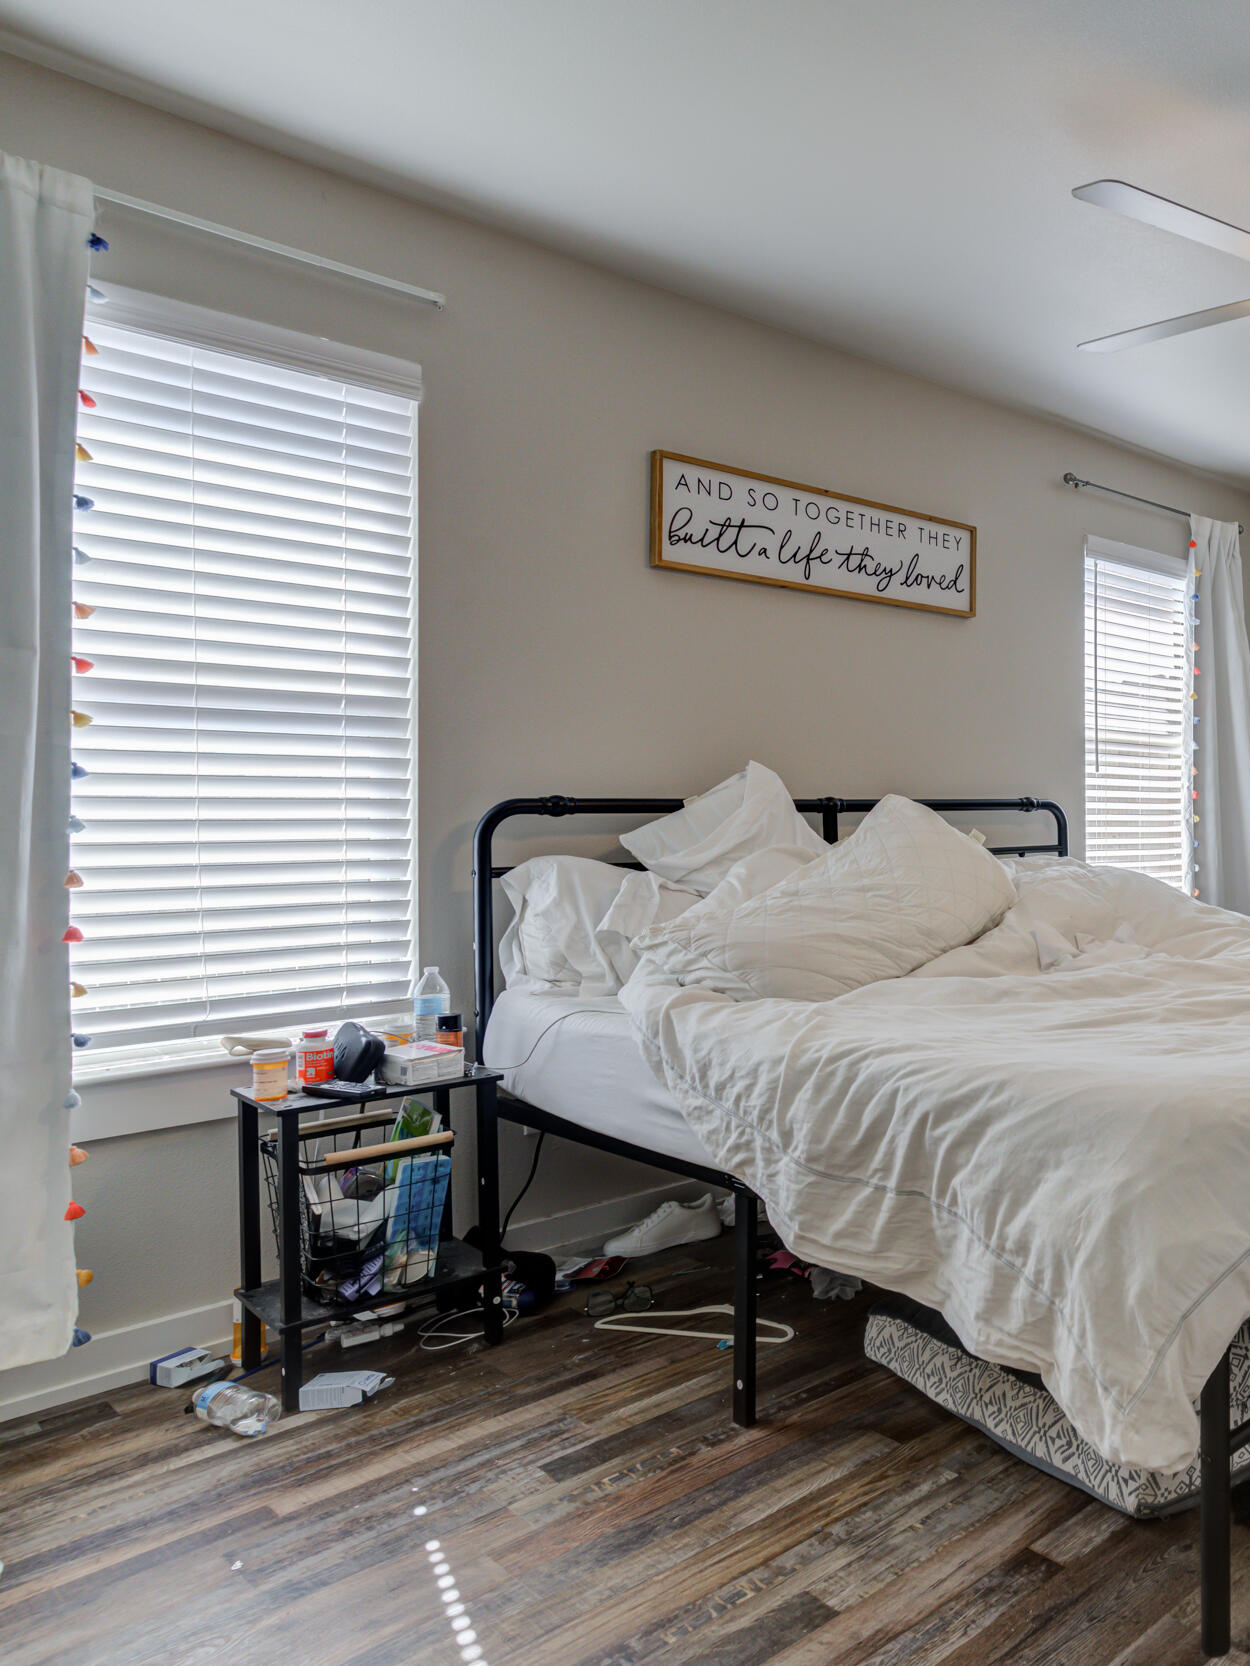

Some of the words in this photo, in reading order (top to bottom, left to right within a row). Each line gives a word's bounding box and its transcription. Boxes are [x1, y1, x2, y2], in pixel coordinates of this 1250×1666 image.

[668, 507, 775, 558] built
[757, 546, 770, 559] a
[777, 530, 832, 580] life
[835, 545, 903, 592] they
[899, 553, 965, 593] loved
[675, 473, 733, 501] AND
[747, 488, 779, 511] SO
[792, 498, 907, 540] TOGETHER
[917, 527, 962, 551] THEY
